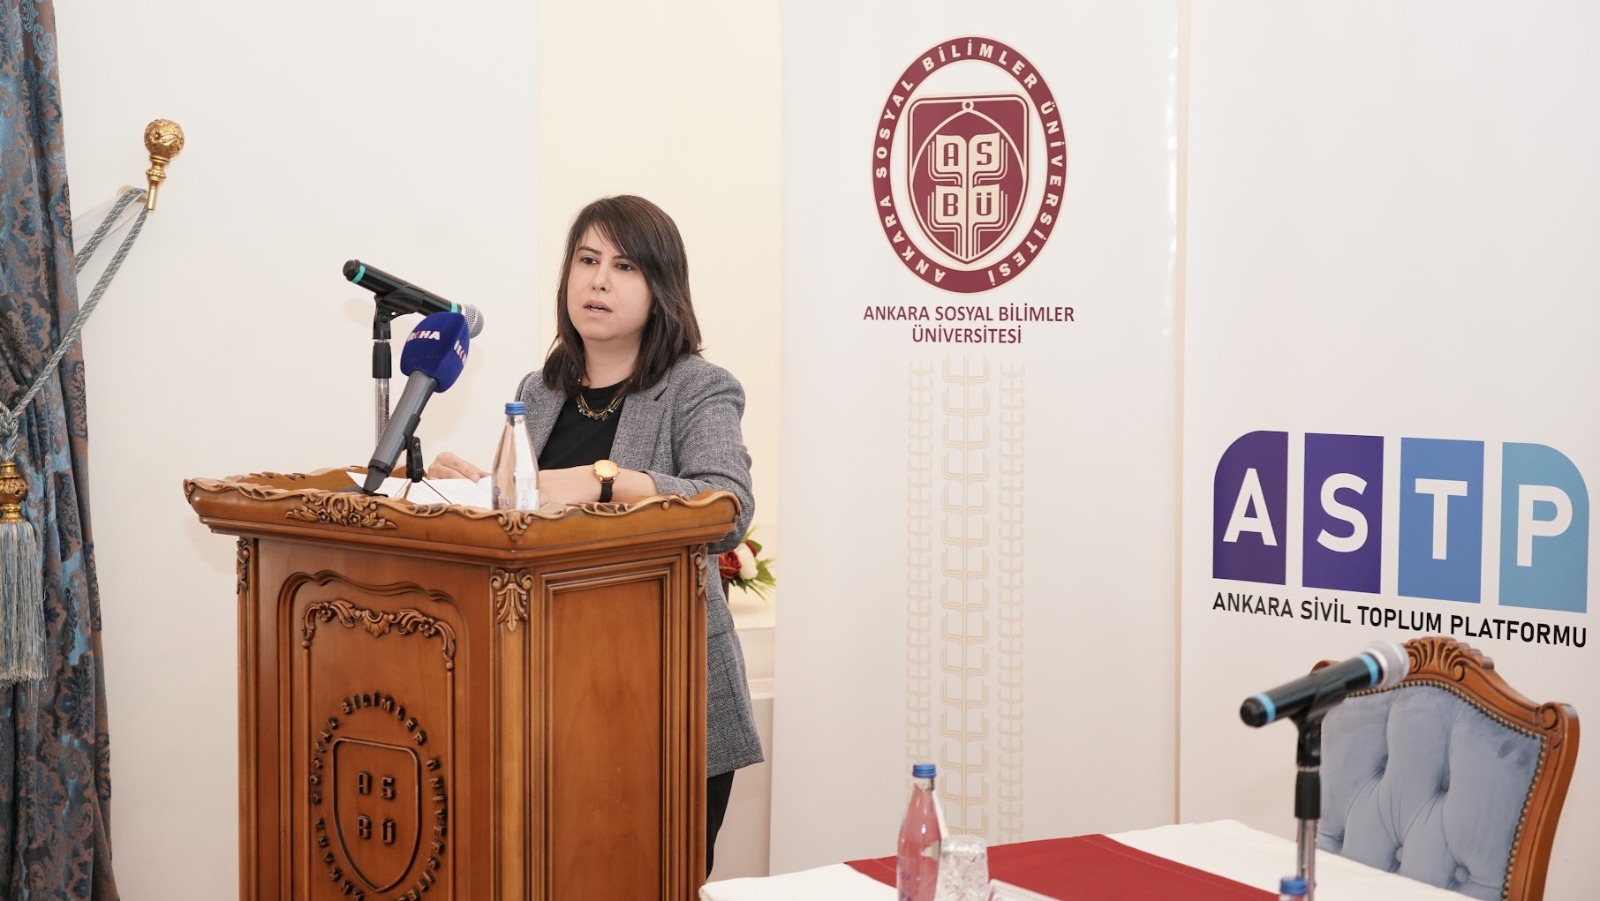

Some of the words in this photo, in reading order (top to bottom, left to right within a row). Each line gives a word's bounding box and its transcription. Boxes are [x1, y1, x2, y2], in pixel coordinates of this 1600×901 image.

[921, 39, 1038, 89] BİLİMLER
[876, 80, 913, 178] SOSYAL
[987, 100, 1066, 286] ÜNİVERSİTESİ
[879, 195, 946, 283] ANKARA
[863, 305, 930, 321] ANKARA
[935, 305, 993, 321] SOSYAL
[998, 302, 1075, 322] BİLİMLER
[912, 324, 1022, 344] ÜNİVERSİTESİ
[1223, 468, 1573, 567] ASTP
[1212, 591, 1294, 619] ANKARA
[1300, 596, 1352, 624] SİVİL
[1357, 605, 1442, 634] TOPLUM
[1450, 615, 1588, 648] PLATFORMU
